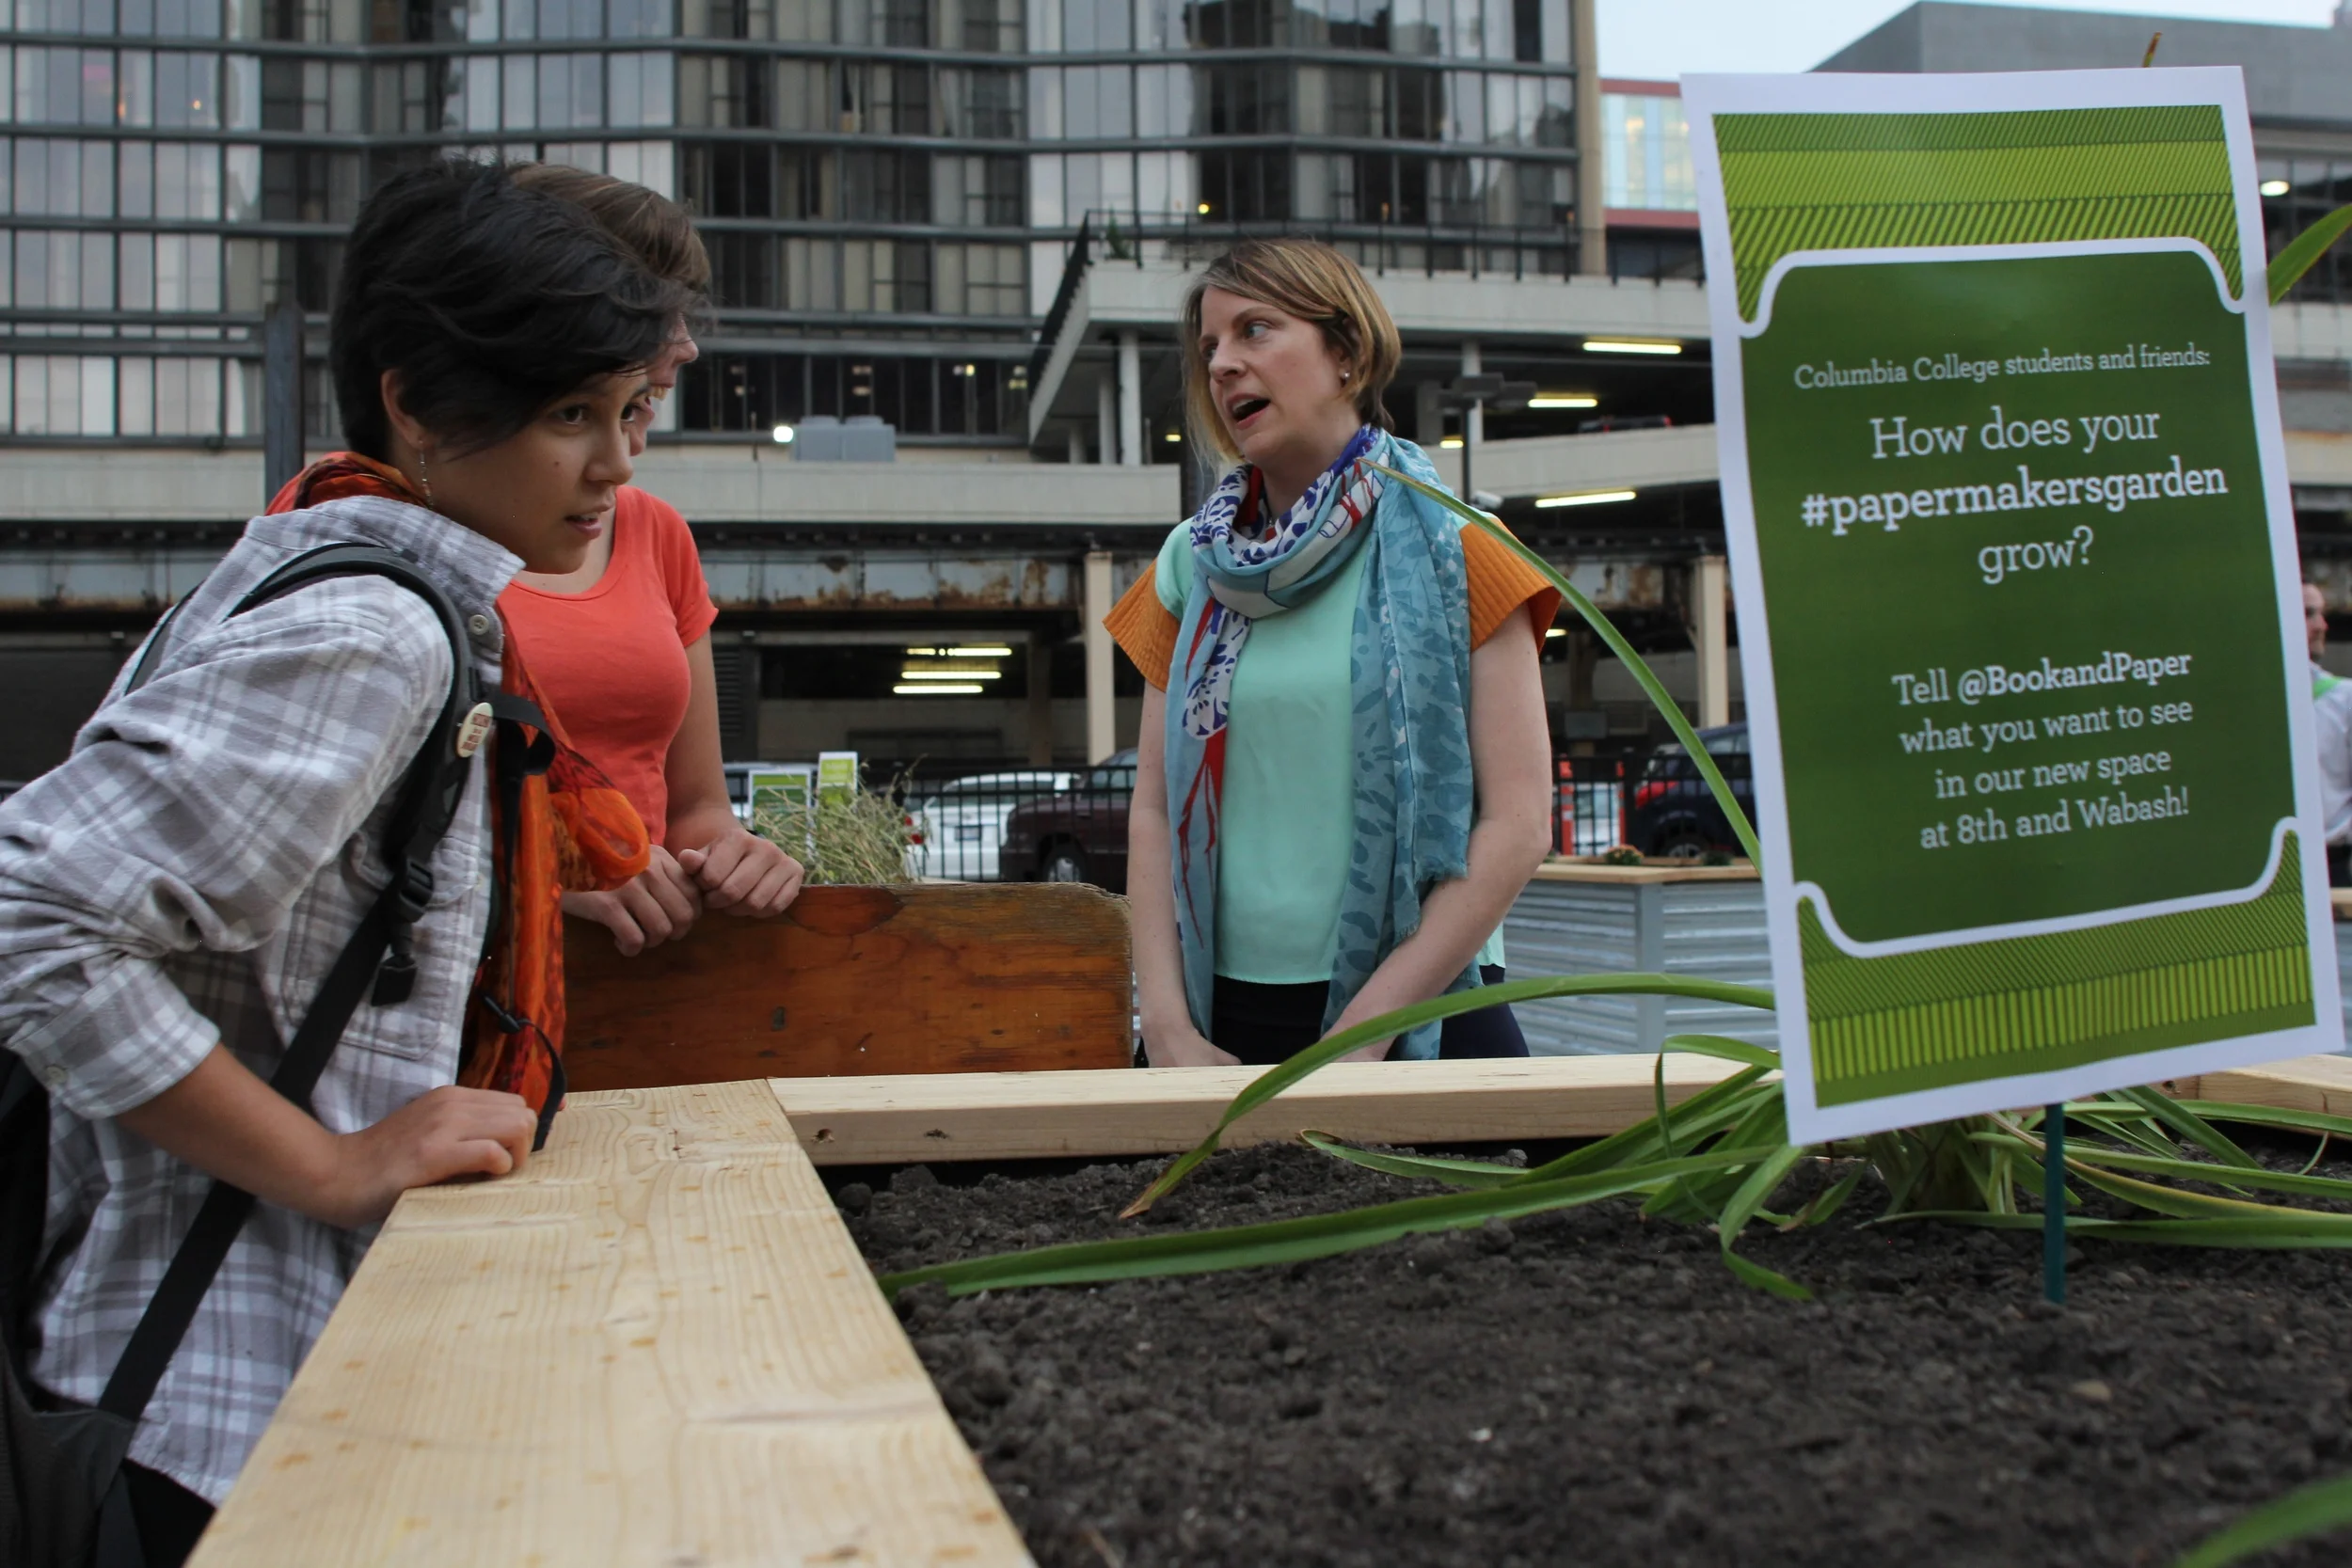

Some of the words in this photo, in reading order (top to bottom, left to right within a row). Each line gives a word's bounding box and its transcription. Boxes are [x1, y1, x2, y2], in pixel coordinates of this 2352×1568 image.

[1794, 357, 1909, 389] Columbia
[1914, 353, 2000, 383] College
[2005, 348, 2094, 374] students
[2099, 344, 2137, 371] and
[2139, 341, 2211, 368] friends:
[1868, 416, 1969, 459] How
[1979, 404, 2072, 450] does
[2078, 412, 2161, 453] your
[1800, 454, 2229, 536] #papermakersgarden
[1978, 524, 2094, 585] grow?
[1891, 667, 1951, 705] Tell
[1957, 651, 2193, 705] @BookandPaper
[1899, 718, 1974, 753] what
[1979, 719, 2037, 752] you
[2042, 707, 2110, 738] want
[2116, 704, 2144, 728] to
[2150, 701, 2194, 725] see
[1934, 768, 1967, 800] in
[1974, 768, 2026, 794] our
[2032, 760, 2091, 788] new
[2097, 750, 2171, 785] space
[1919, 822, 1950, 849] at
[1956, 807, 2009, 845] 8th
[2015, 799, 2073, 837] and
[2075, 784, 2190, 829] Wabash!
